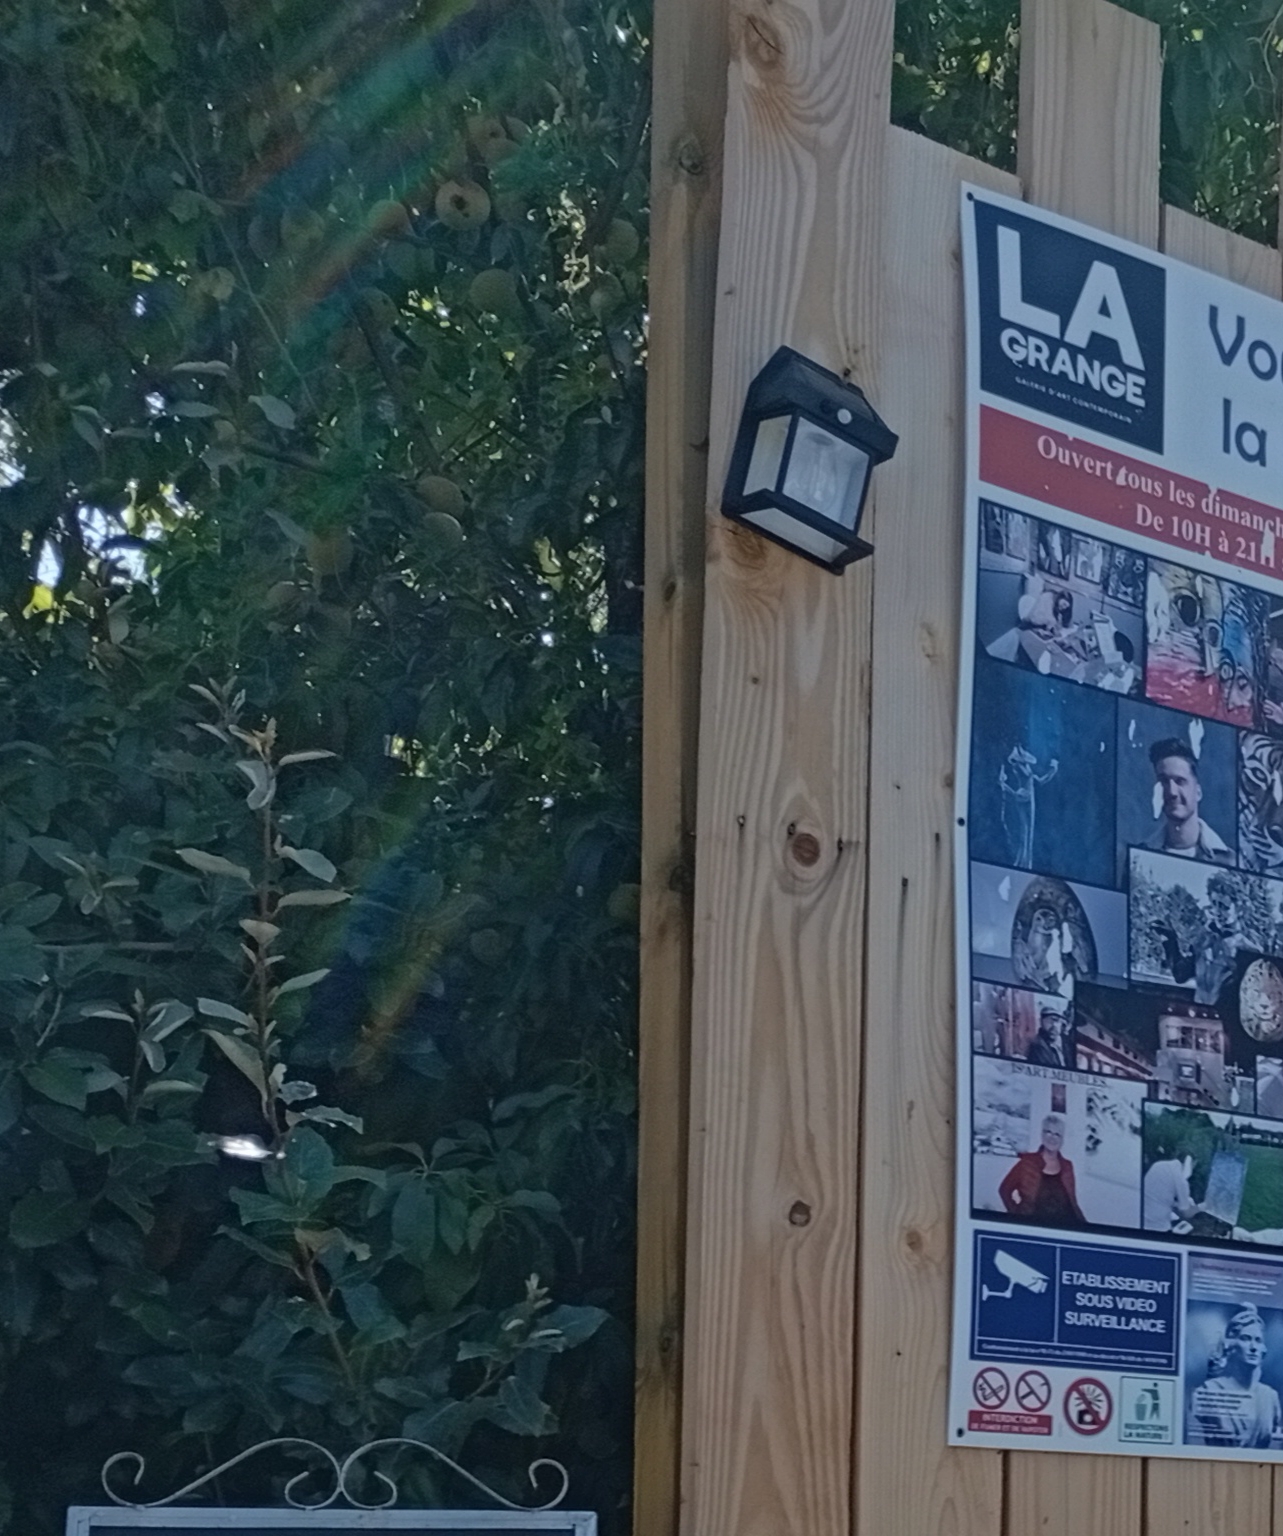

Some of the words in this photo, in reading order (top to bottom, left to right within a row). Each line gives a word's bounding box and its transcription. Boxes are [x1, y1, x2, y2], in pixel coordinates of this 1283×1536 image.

[997, 225, 1145, 371] LA
[1000, 327, 1146, 408] GRANGE
[1072, 396, 1132, 424] CONTEMPORAIN
[1222, 397, 1267, 467] la
[1037, 434, 1113, 482] Ouvert
[1120, 465, 1163, 498] tous
[1169, 480, 1196, 509] les
[1136, 502, 1165, 532] De
[1171, 516, 1212, 548] 10H
[1218, 530, 1229, 554] à
[1061, 1270, 1172, 1294] ETABLISSEMENT
[1064, 1310, 1167, 1333] SURVEILLANCE
[1075, 1292, 1114, 1309] SOUS
[1115, 1296, 1158, 1313] VIDEO
[982, 1413, 1037, 1424] INTERDICTION
